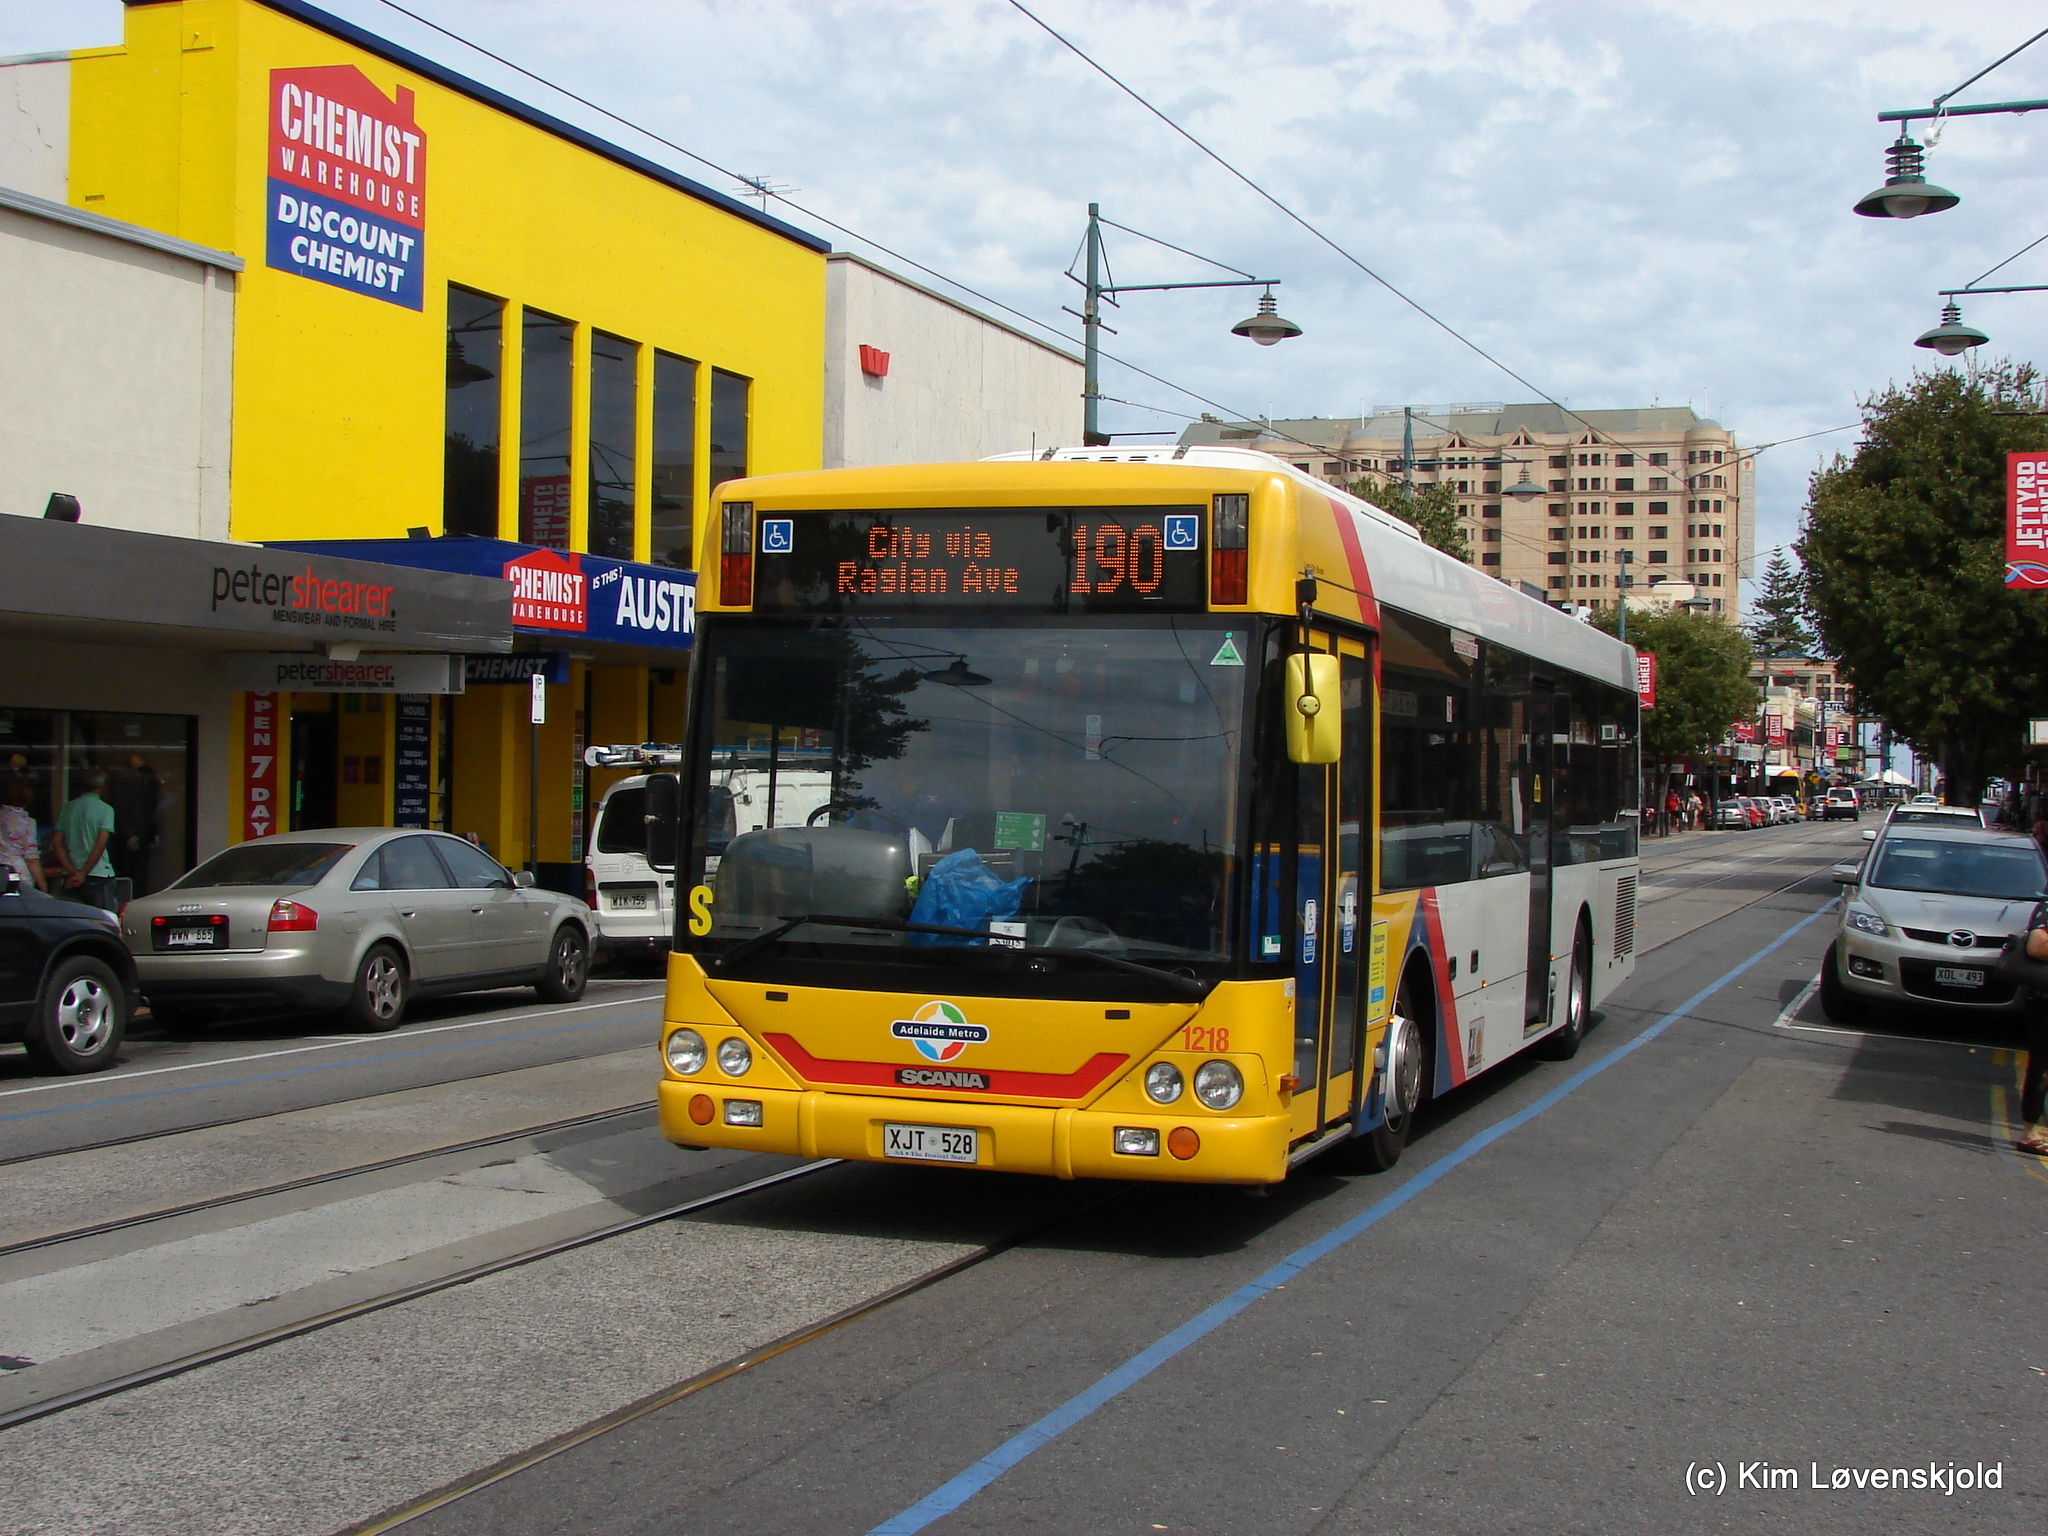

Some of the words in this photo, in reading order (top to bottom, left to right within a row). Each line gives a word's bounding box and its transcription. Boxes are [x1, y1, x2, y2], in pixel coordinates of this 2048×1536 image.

[281, 83, 420, 185] CHEMIST
[280, 146, 419, 219] WAREHOUSE
[278, 193, 415, 263] DISCOUNT
[290, 235, 405, 293] CHEMIST
[2016, 461, 2043, 549] JETTYRD
[868, 526, 931, 558] City
[945, 526, 992, 558] via
[1071, 524, 1163, 594] 190
[509, 565, 583, 605] CHEMIST
[592, 576, 600, 590] IS
[961, 561, 1019, 594] Ave
[273, 609, 322, 625] MENSWEAR
[324, 614, 341, 627] AND
[343, 616, 376, 631] FORMAL
[379, 619, 396, 632] HIRE
[1641, 657, 1650, 694] GLENELG
[403, 706, 426, 716] HOURS
[251, 755, 273, 778] 7
[689, 885, 713, 936] S
[1965, 971, 1983, 982] 493
[900, 1025, 947, 1038] Adelaide
[948, 1027, 980, 1040] Metro
[1181, 1026, 1230, 1053] 1218
[900, 1069, 985, 1089] SCANIA
[890, 1129, 925, 1151] XJT
[942, 1132, 973, 1155] 528
